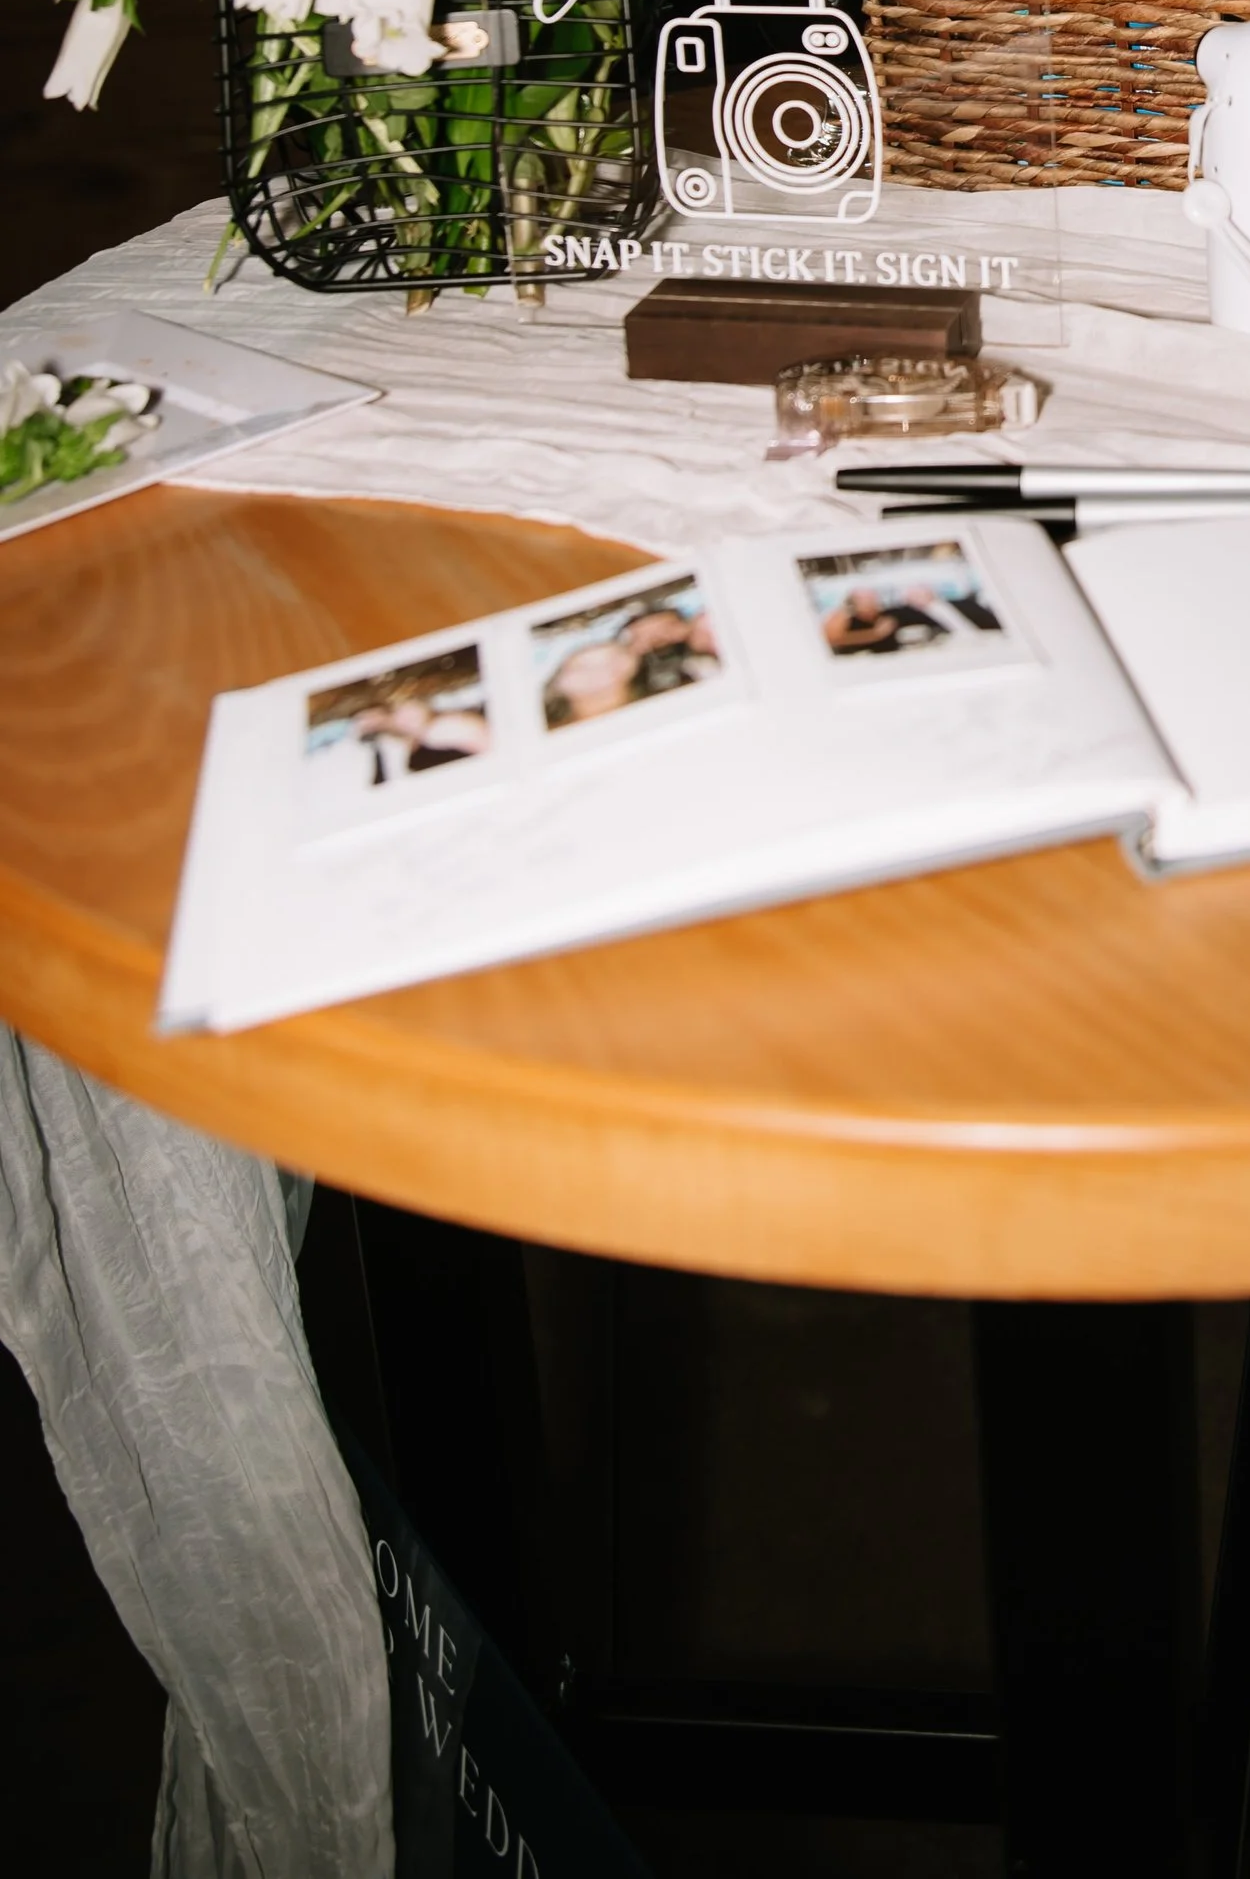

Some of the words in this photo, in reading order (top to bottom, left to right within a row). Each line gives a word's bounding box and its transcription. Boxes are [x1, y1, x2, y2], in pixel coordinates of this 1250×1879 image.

[543, 234, 643, 271] SNAP
[650, 241, 694, 275] IT.
[702, 244, 814, 282] STICK
[823, 250, 866, 284] IT.
[875, 252, 966, 288] SIGN
[979, 256, 1018, 290] IT
[376, 1539, 457, 1696] OME
